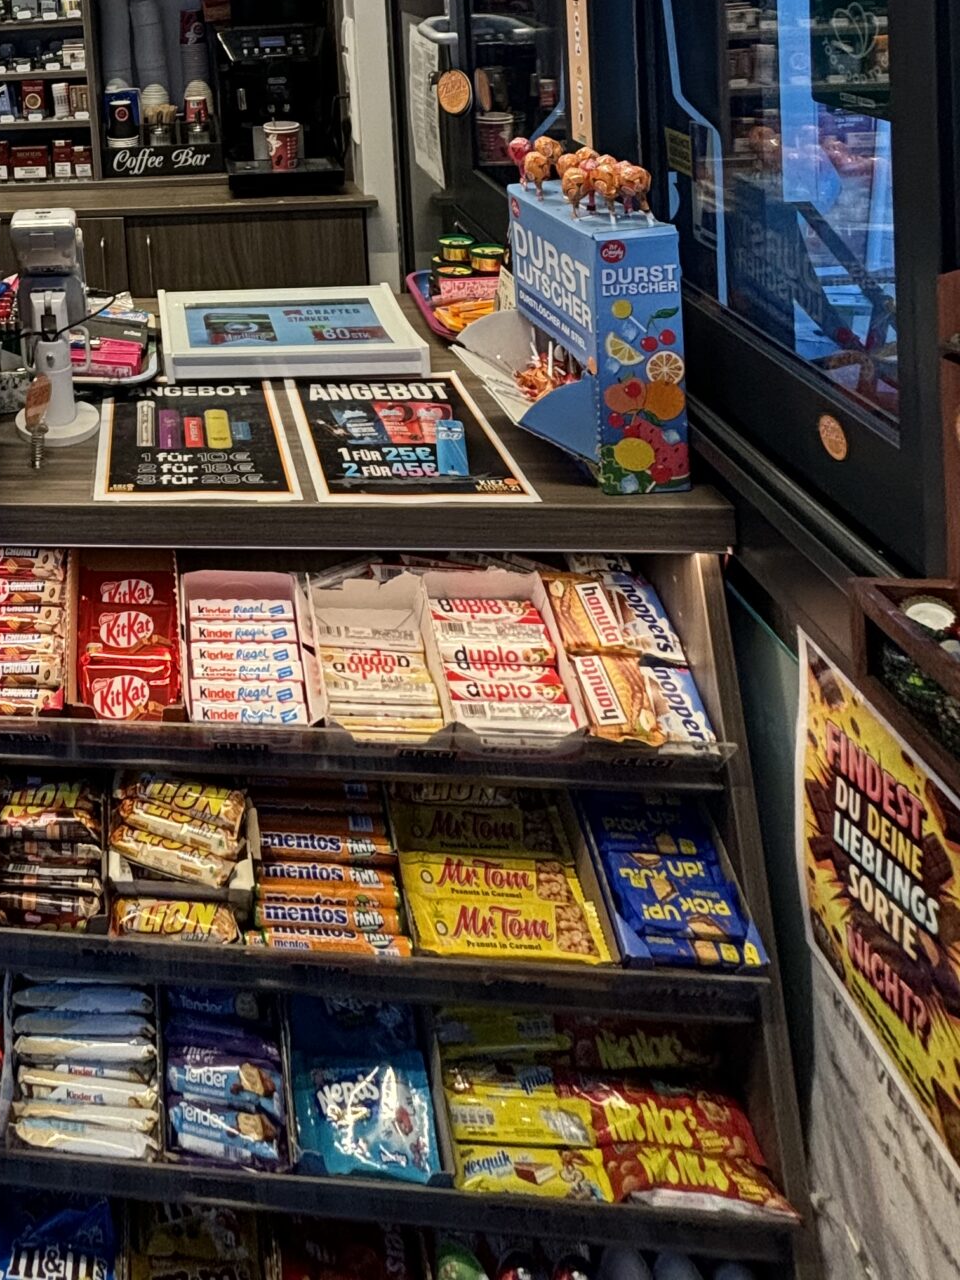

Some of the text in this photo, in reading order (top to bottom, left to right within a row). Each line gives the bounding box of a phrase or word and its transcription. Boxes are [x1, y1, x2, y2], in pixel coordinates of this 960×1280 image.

[112, 146, 211, 175] Coffee Bar
[513, 220, 591, 302] DURST
[601, 264, 678, 286] DURST
[515, 257, 593, 333] LUTSCHER
[602, 281, 679, 296] LUTSCHER
[306, 307, 361, 317] CRAFTED
[323, 327, 351, 341] 60
[128, 385, 251, 398] ANGEBOT
[309, 383, 448, 401] ANGEBOT
[141, 451, 252, 462] 1 für 10€
[338, 447, 436, 462] 1 FÜR 25€
[136, 474, 264, 485] 3 für 26€
[138, 462, 256, 474] 2 für 18€
[342, 462, 440, 477] 2 FÜR 45€
[9, 581, 44, 592] CHUNKY
[583, 586, 619, 642] hanuta
[100, 614, 152, 647] KitKat
[198, 625, 269, 641] kinder Riegel
[455, 644, 520, 671] duplo
[825, 720, 925, 837] FINDEST
[835, 775, 924, 882] DU DEINE
[832, 809, 942, 935] LIEBLINGS
[141, 902, 216, 933] LION
[263, 903, 384, 929] mentos FANTA
[453, 905, 555, 941] Mr. Tom
[847, 863, 918, 962] SORTE
[846, 923, 928, 1038] NICHT?
[184, 1065, 228, 1087] Tender
[463, 1148, 512, 1179] Nesquik
